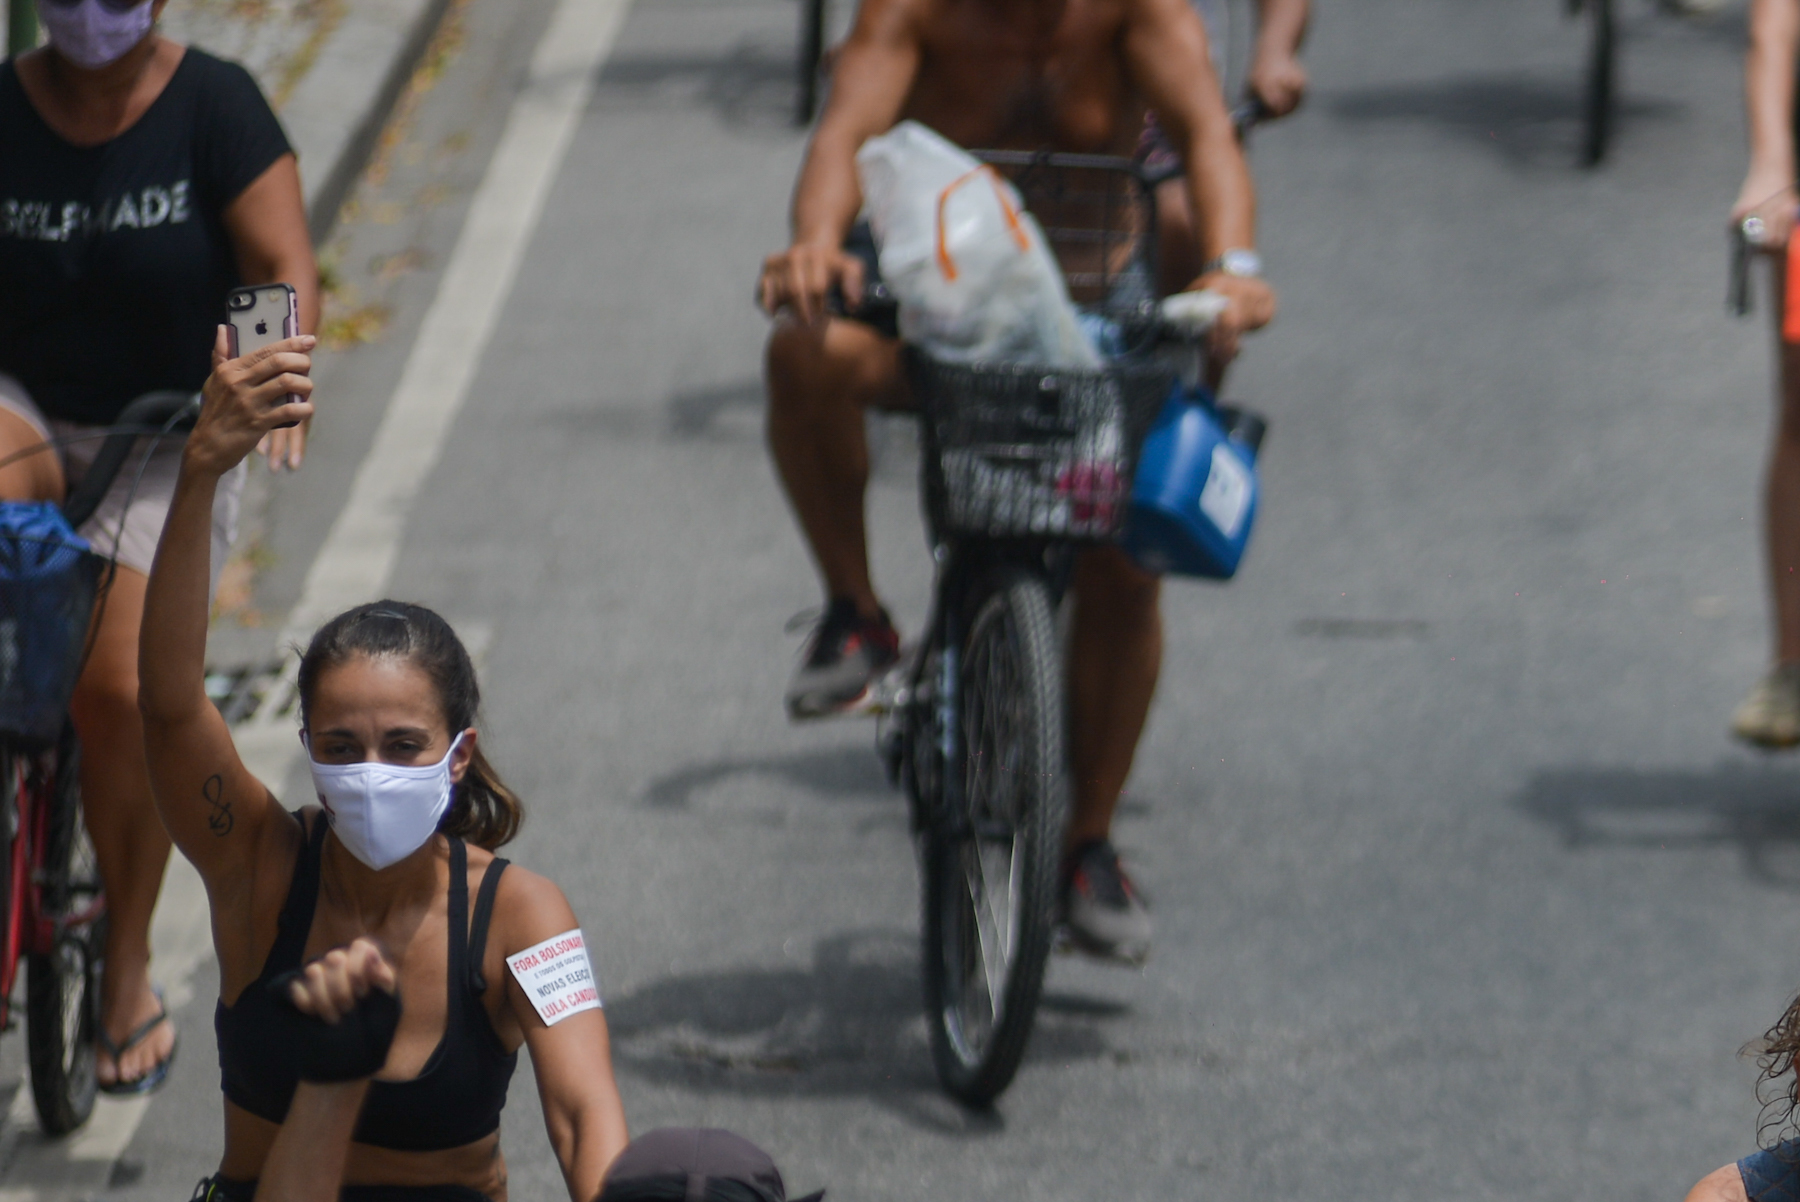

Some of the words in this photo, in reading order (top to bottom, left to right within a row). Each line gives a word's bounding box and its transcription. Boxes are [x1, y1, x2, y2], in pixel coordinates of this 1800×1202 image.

[513, 954, 541, 974] FORA
[539, 965, 556, 977] TODOS
[536, 977, 567, 998] NOVAS
[540, 998, 569, 1019] LULA
